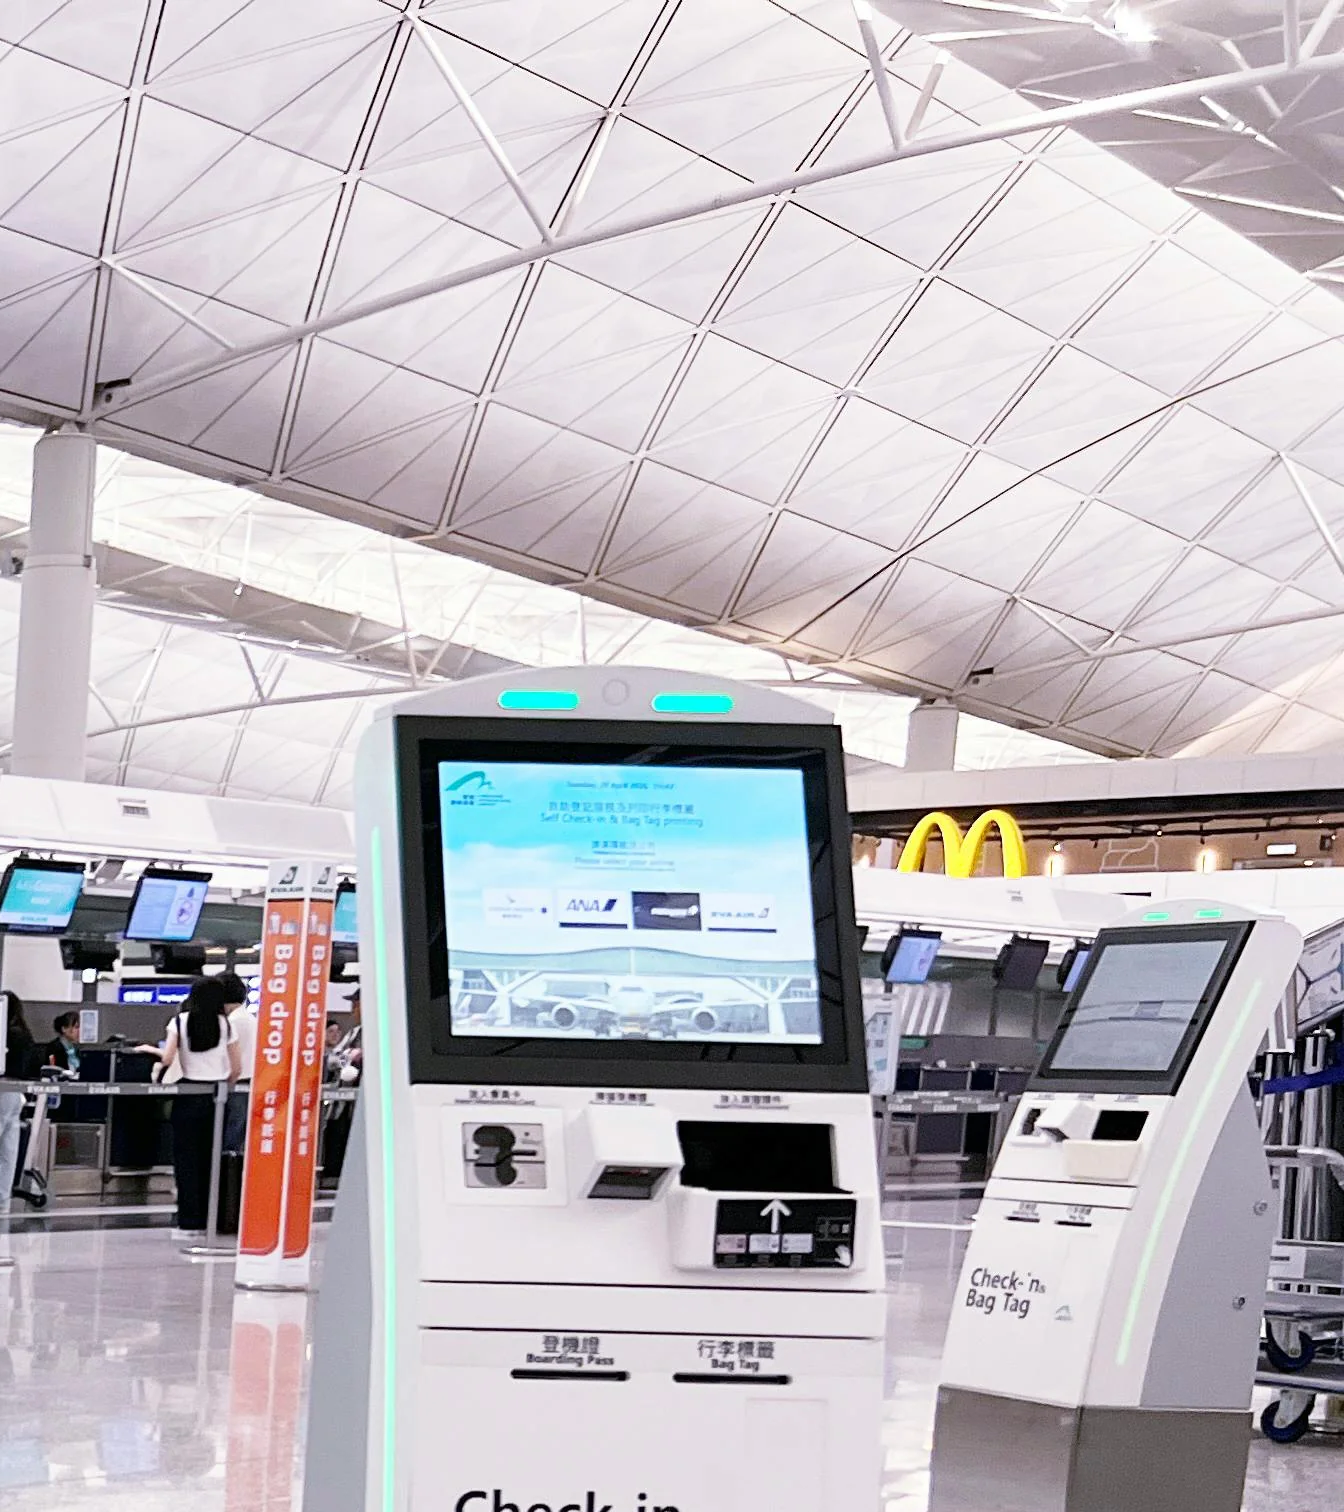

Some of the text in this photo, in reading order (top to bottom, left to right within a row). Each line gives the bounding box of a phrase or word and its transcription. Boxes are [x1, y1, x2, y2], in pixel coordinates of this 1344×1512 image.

[566, 899, 600, 912] ANA
[263, 944, 294, 1065] Bag drop
[302, 944, 326, 1066] Bag drop
[965, 1288, 1032, 1320] Bag Tag
[526, 1353, 615, 1367] Boarding Pass
[711, 1358, 760, 1373] Bag Tag
